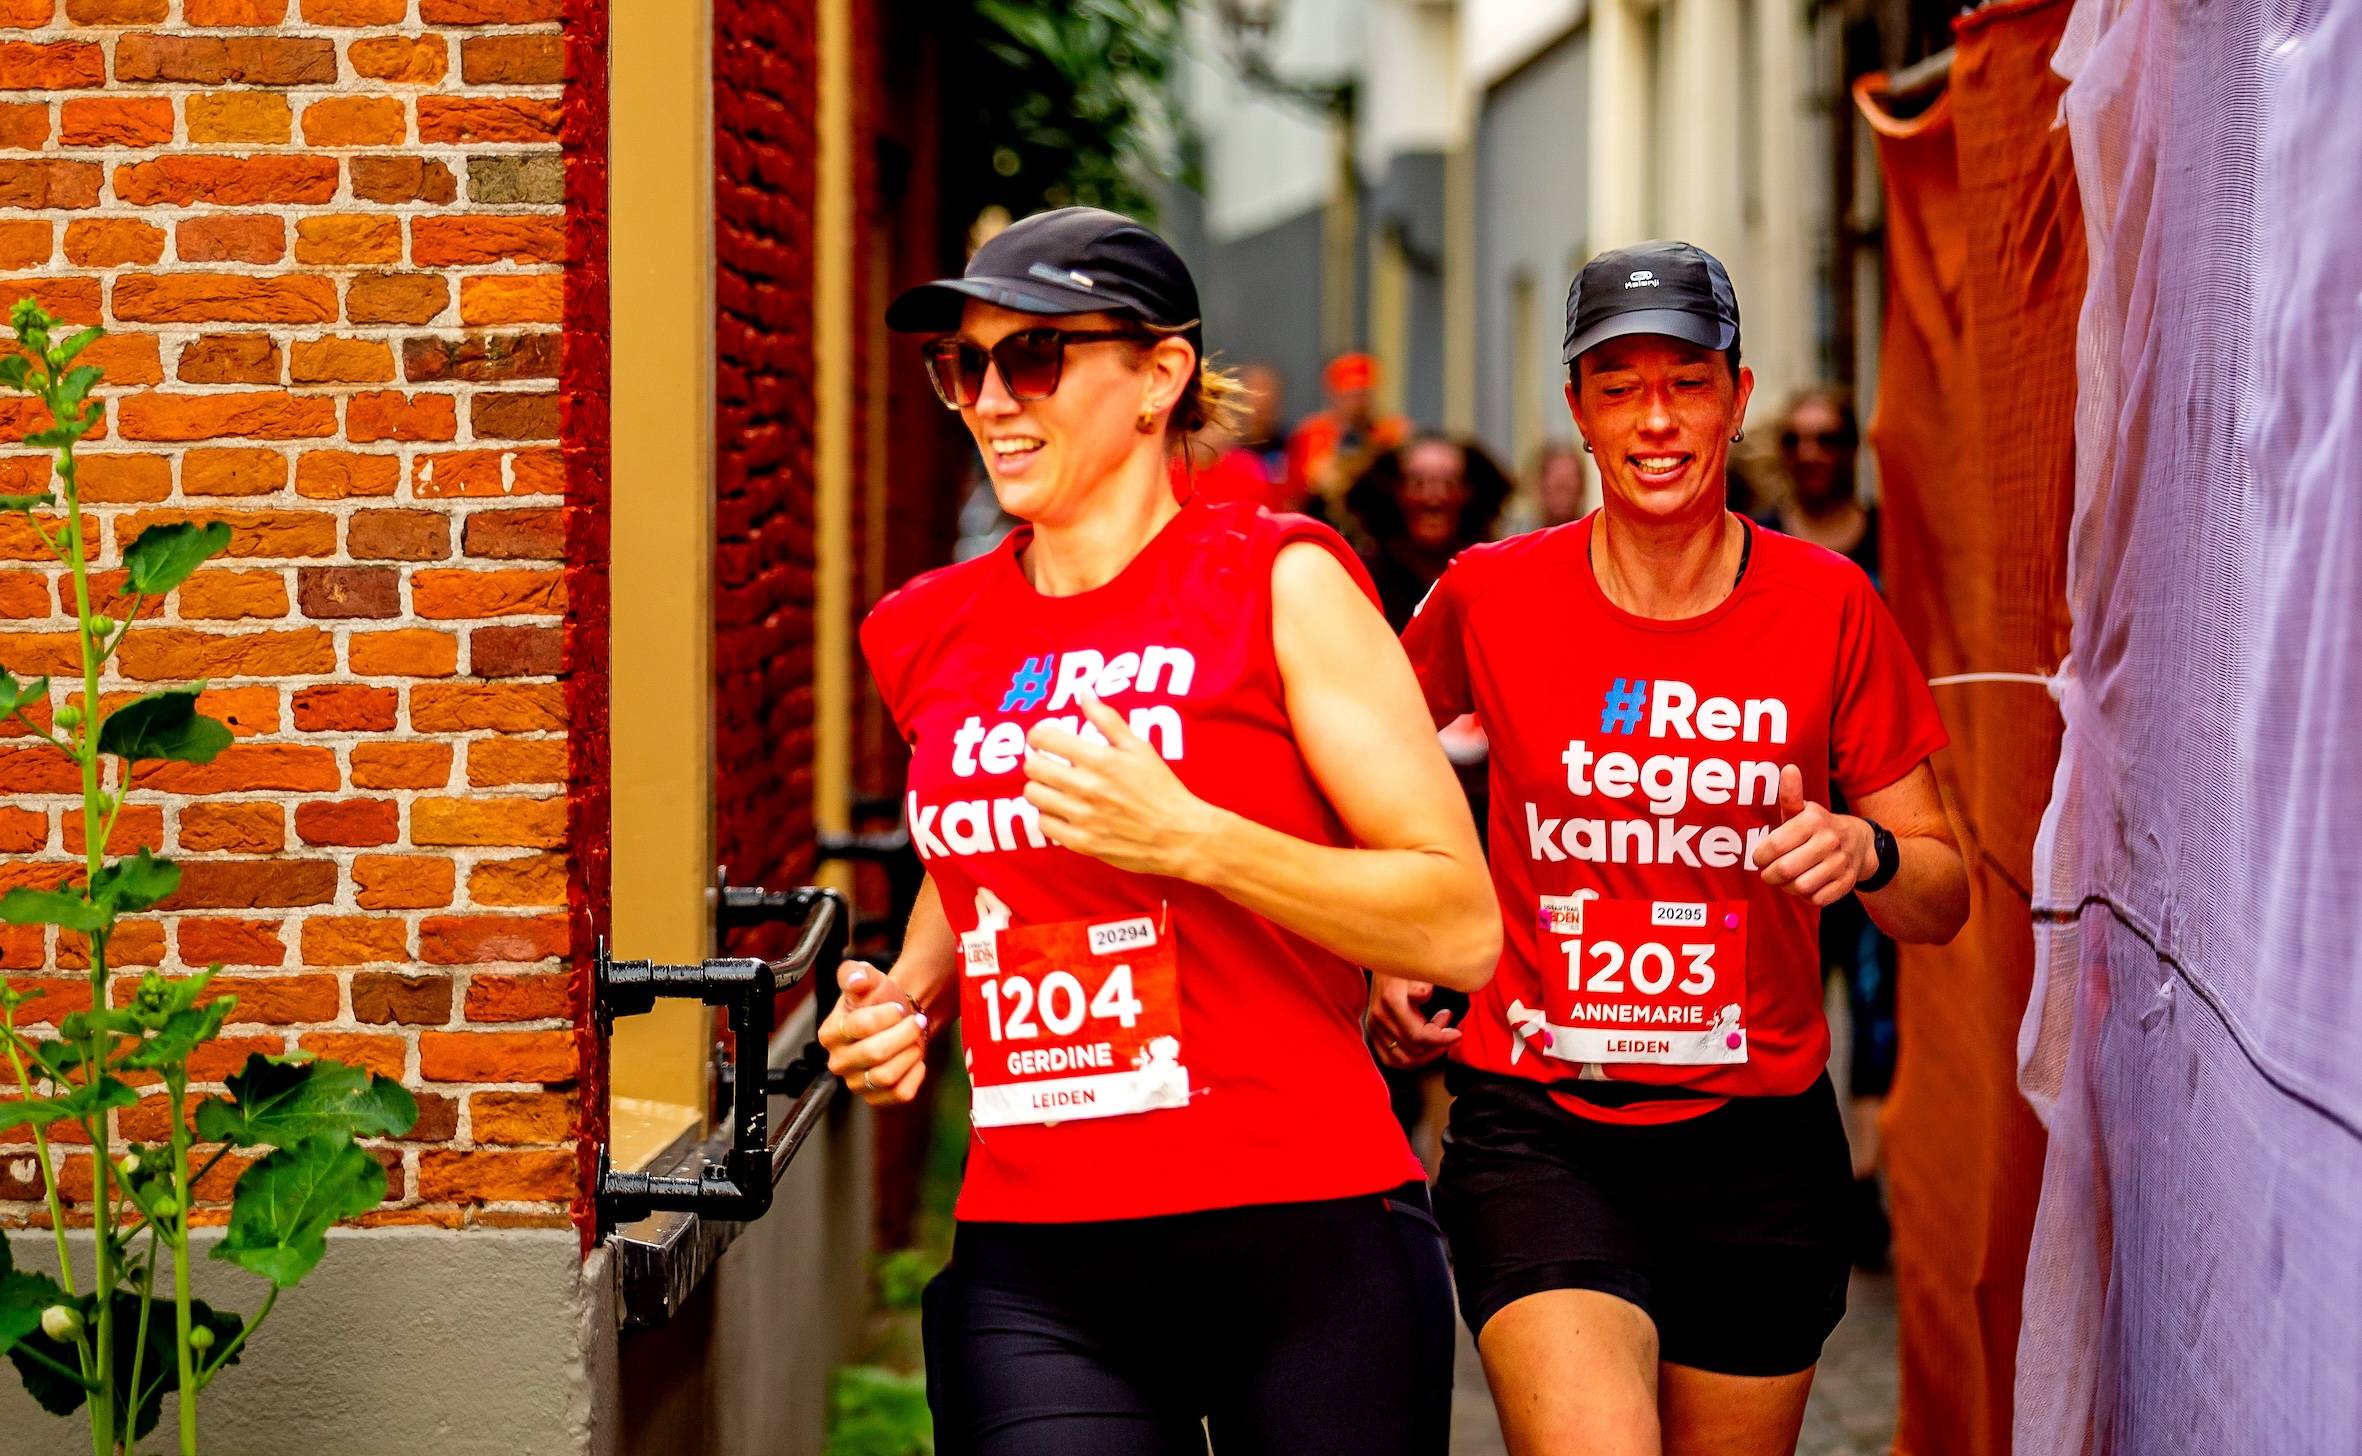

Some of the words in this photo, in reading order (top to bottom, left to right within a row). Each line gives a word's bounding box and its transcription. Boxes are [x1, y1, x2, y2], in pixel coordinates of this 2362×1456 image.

[998, 645, 1195, 711] #Ren
[1600, 677, 1788, 744] #Ren
[1561, 739, 1781, 816] tegen
[1657, 907, 1702, 921] 20295
[1096, 925, 1148, 946] 20294
[1560, 938, 1716, 996] 1203
[980, 963, 1144, 1041] 1204
[1570, 1002, 1704, 1024] ANNEMARIE
[1007, 1042, 1113, 1076] GERDINE
[1607, 1039, 1670, 1054] LEIDEN
[1032, 1088, 1096, 1109] LEIDEN
